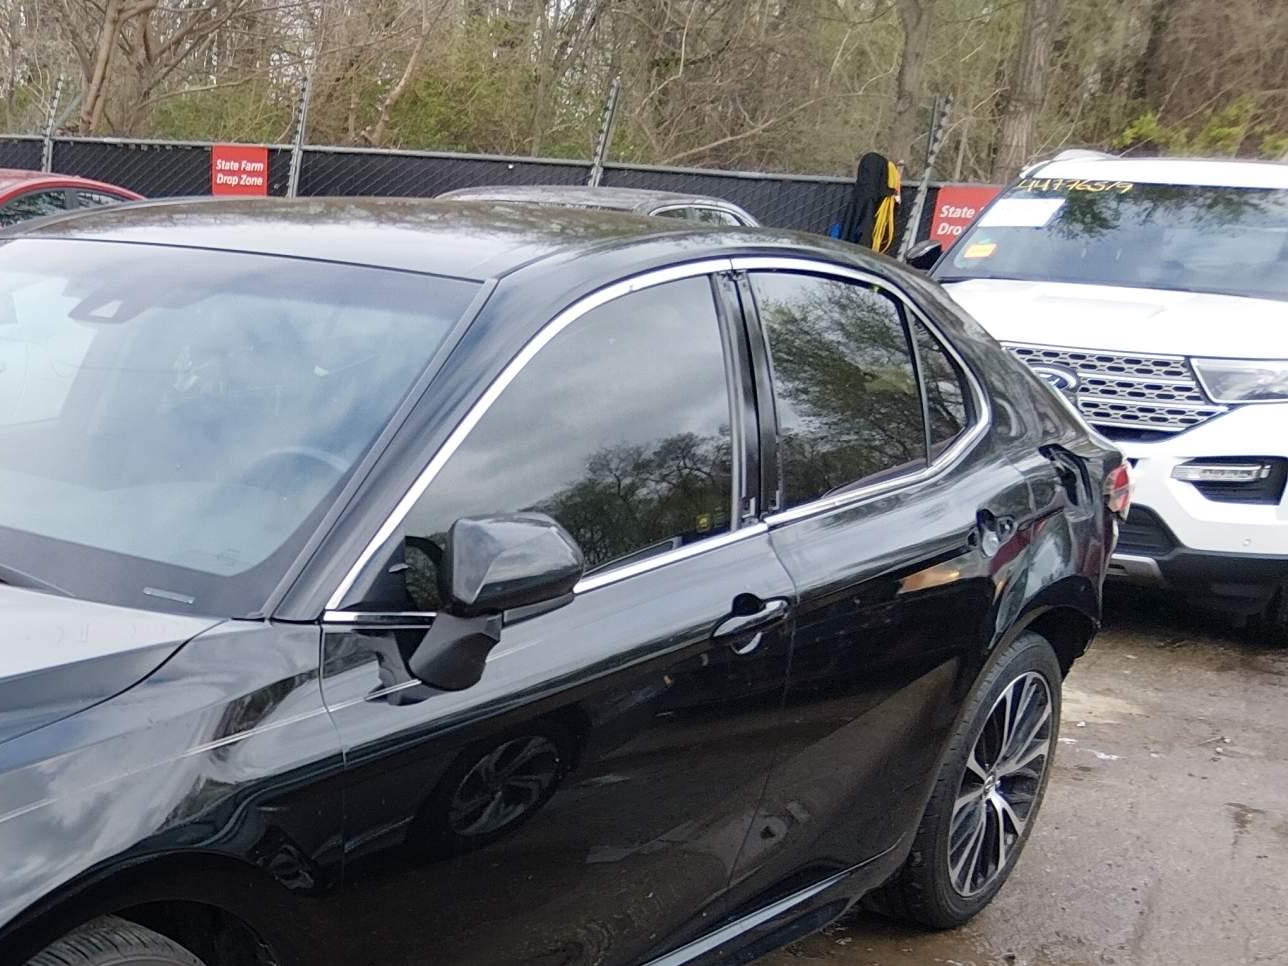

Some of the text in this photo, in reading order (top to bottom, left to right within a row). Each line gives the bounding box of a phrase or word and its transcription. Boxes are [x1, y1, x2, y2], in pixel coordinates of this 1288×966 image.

[215, 159, 264, 172] State Farm
[216, 173, 263, 187] Drop Zone
[939, 205, 976, 218] State
[937, 222, 966, 236] Dro
